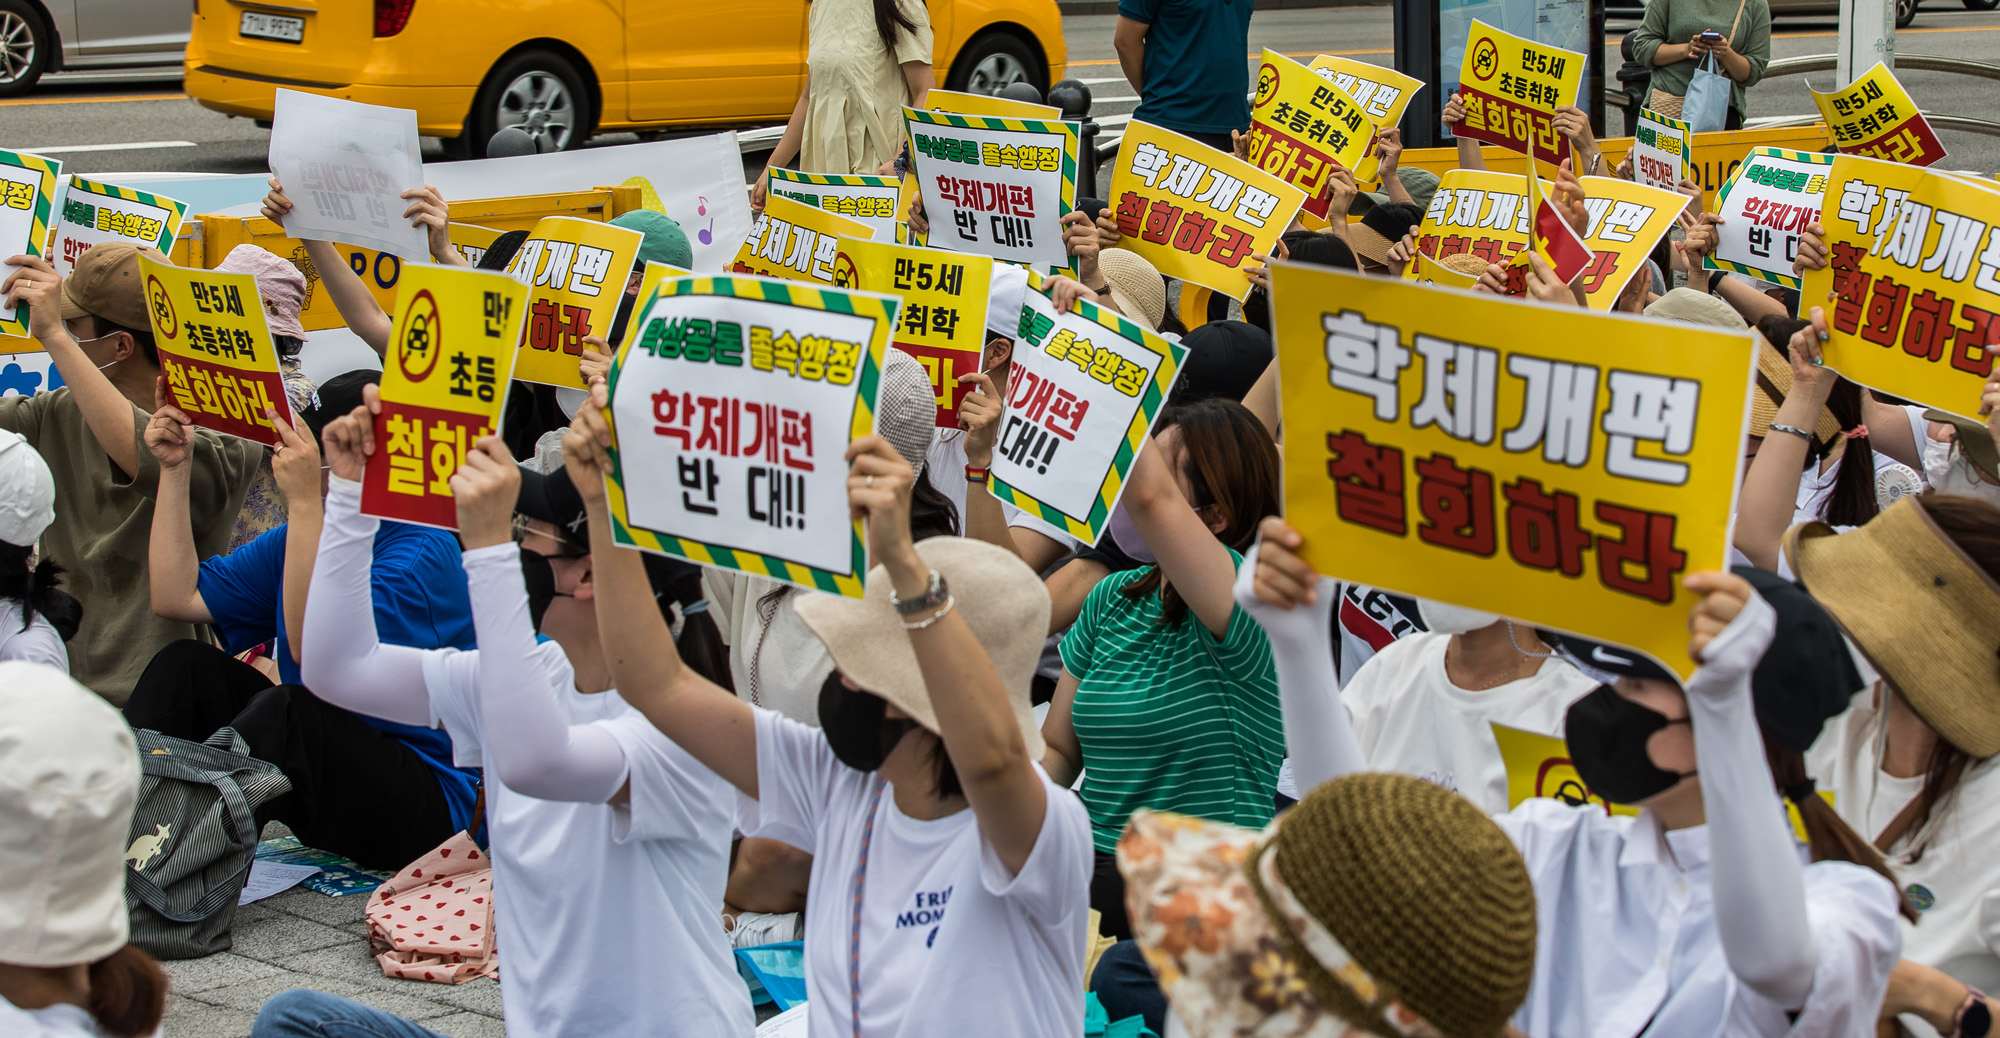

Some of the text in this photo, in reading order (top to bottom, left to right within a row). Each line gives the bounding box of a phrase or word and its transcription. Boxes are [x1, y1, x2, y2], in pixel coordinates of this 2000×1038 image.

[1521, 48, 1566, 80] 만5세
[1309, 85, 1363, 133] 만5세
[1499, 72, 1560, 110] 초등취학
[1832, 79, 1884, 117] 만5세
[1270, 101, 1349, 155] 초등취학
[1463, 91, 1561, 155] 철회하라
[1831, 102, 1899, 142] 초등취학
[914, 133, 1060, 172] 탁상공론 졸속행정
[1657, 131, 1682, 156] 졸속행정
[1130, 141, 1281, 229] 학제개편
[1639, 154, 1675, 187] 학제개편
[1745, 164, 1809, 193] 탁상공론
[822, 195, 895, 218] 졸속행정
[936, 174, 1036, 218] 학제개편
[97, 206, 162, 241] 졸속행정
[953, 208, 1034, 248] 반 대!!
[1116, 190, 1255, 269] 철회하라
[1749, 226, 1772, 258] 반
[893, 258, 964, 296] 만5세
[189, 281, 245, 317] 만5세
[184, 320, 256, 362] 초등취학
[639, 315, 862, 387] 탁상공론 졸속행정
[1045, 327, 1149, 398] 졸속행정
[164, 358, 278, 433] 철회하라
[1320, 308, 1702, 487] 학제개편
[650, 388, 815, 473] 학제개편
[999, 414, 1080, 475] 대!!
[677, 455, 806, 531] 반 대!!
[1326, 428, 1688, 606] 철회하라
